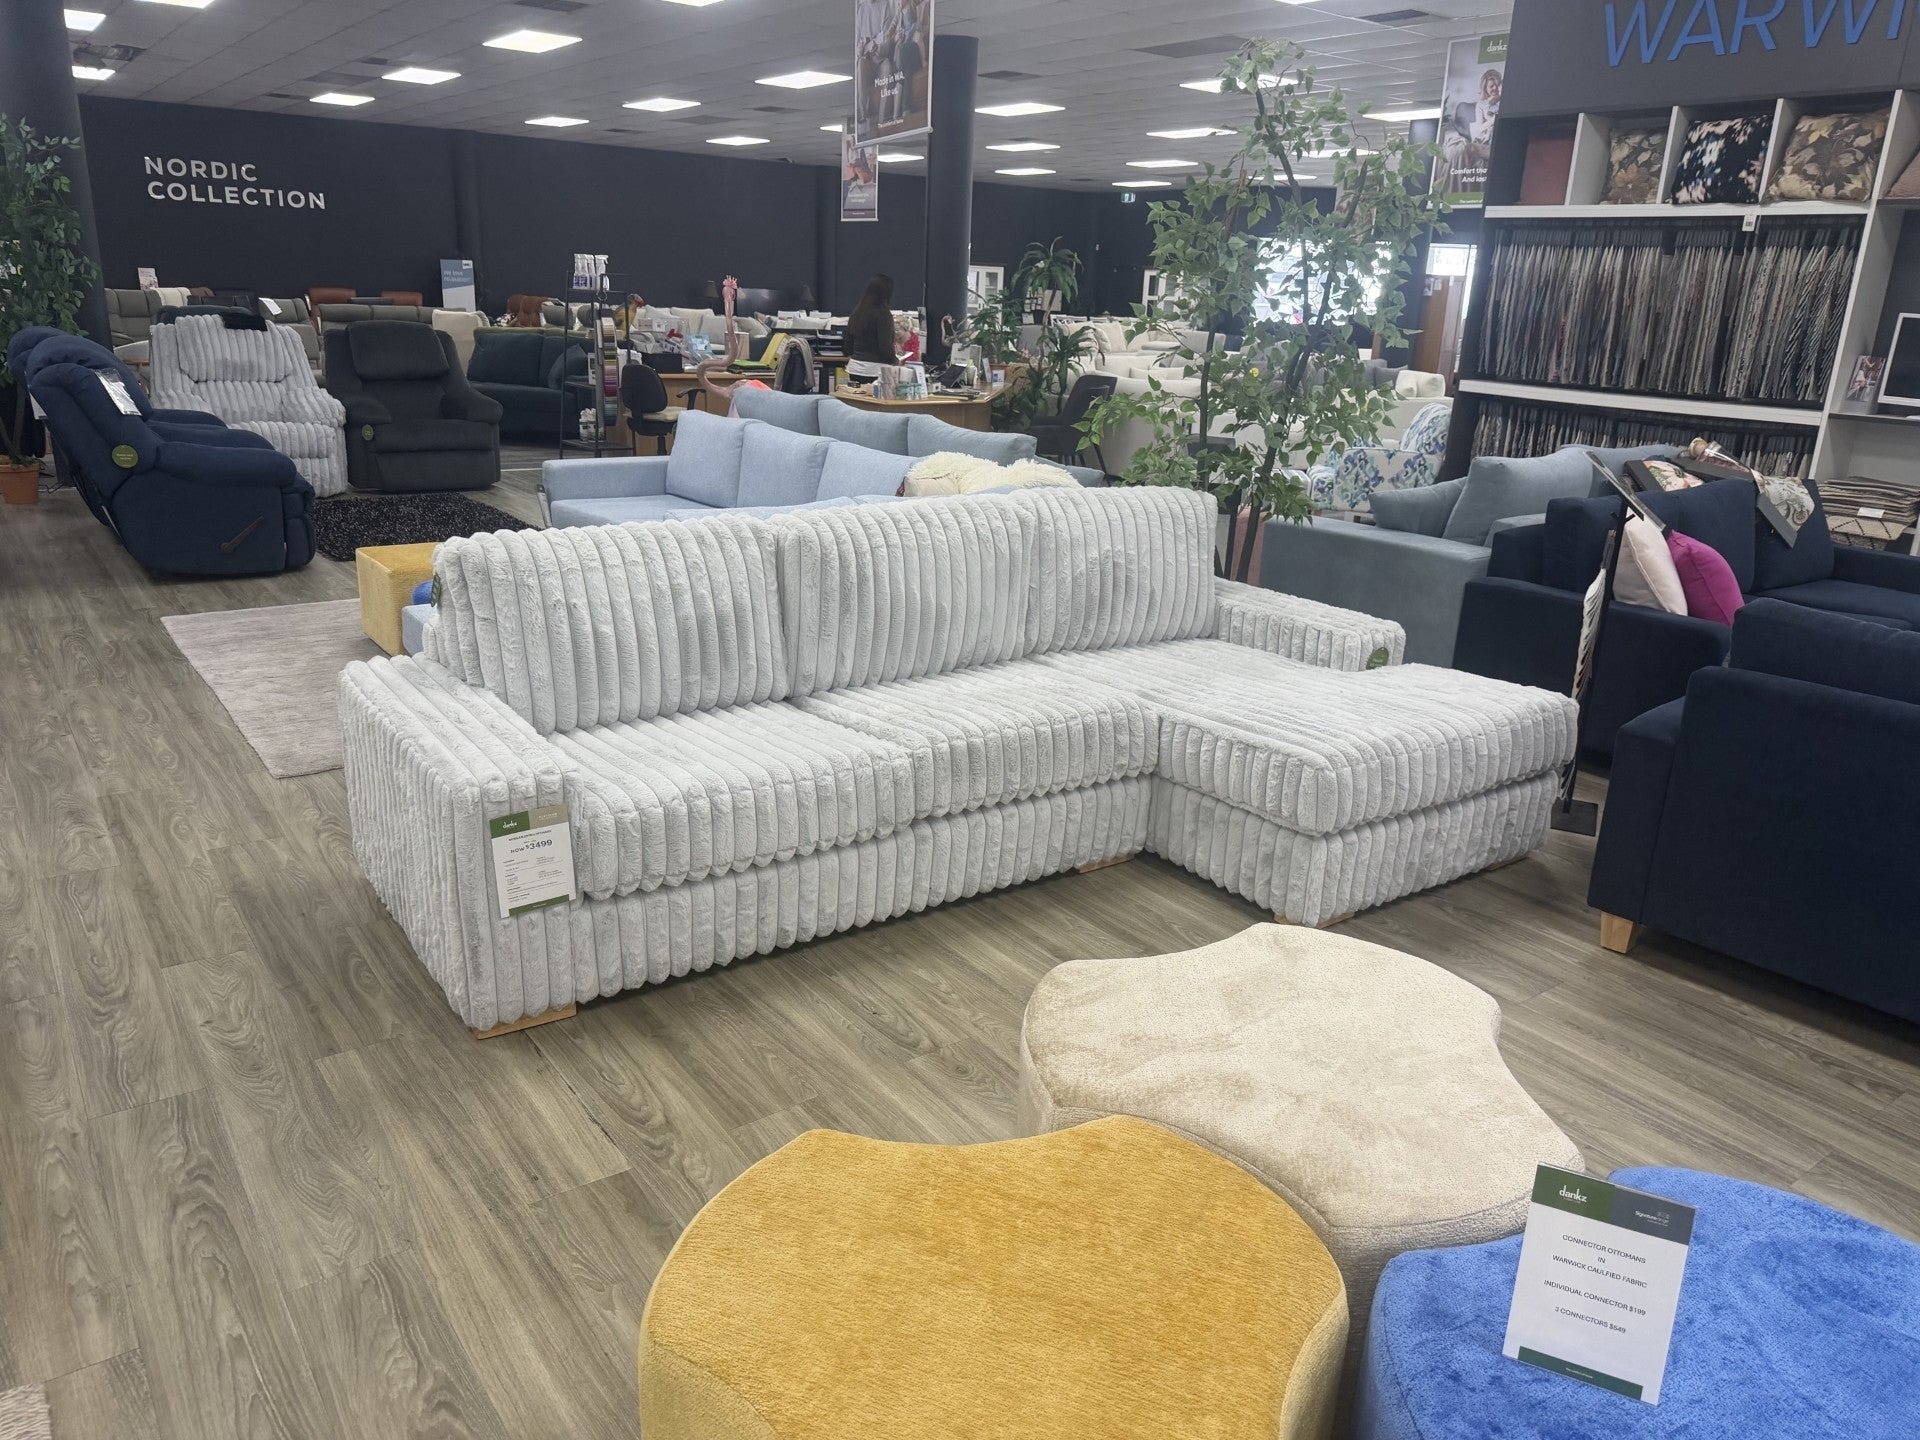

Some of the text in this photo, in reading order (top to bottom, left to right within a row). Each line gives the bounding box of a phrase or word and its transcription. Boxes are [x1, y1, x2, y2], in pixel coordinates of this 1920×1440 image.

[1605, 0, 1920, 67] WARWI
[144, 156, 257, 182] NORDIC
[147, 181, 326, 210] COLLECTION
[525, 839, 552, 850] $3499
[1562, 1234, 1646, 1264] CONNECTOR OTTOMANS
[1597, 1256, 1606, 1264] IN
[1552, 1254, 1647, 1288] WARWICK CAULFIED FABRIC
[1544, 1279, 1646, 1316] INDIVIDUAL CONNECTOR $199
[1560, 1307, 1608, 1328] CONNECTORS
